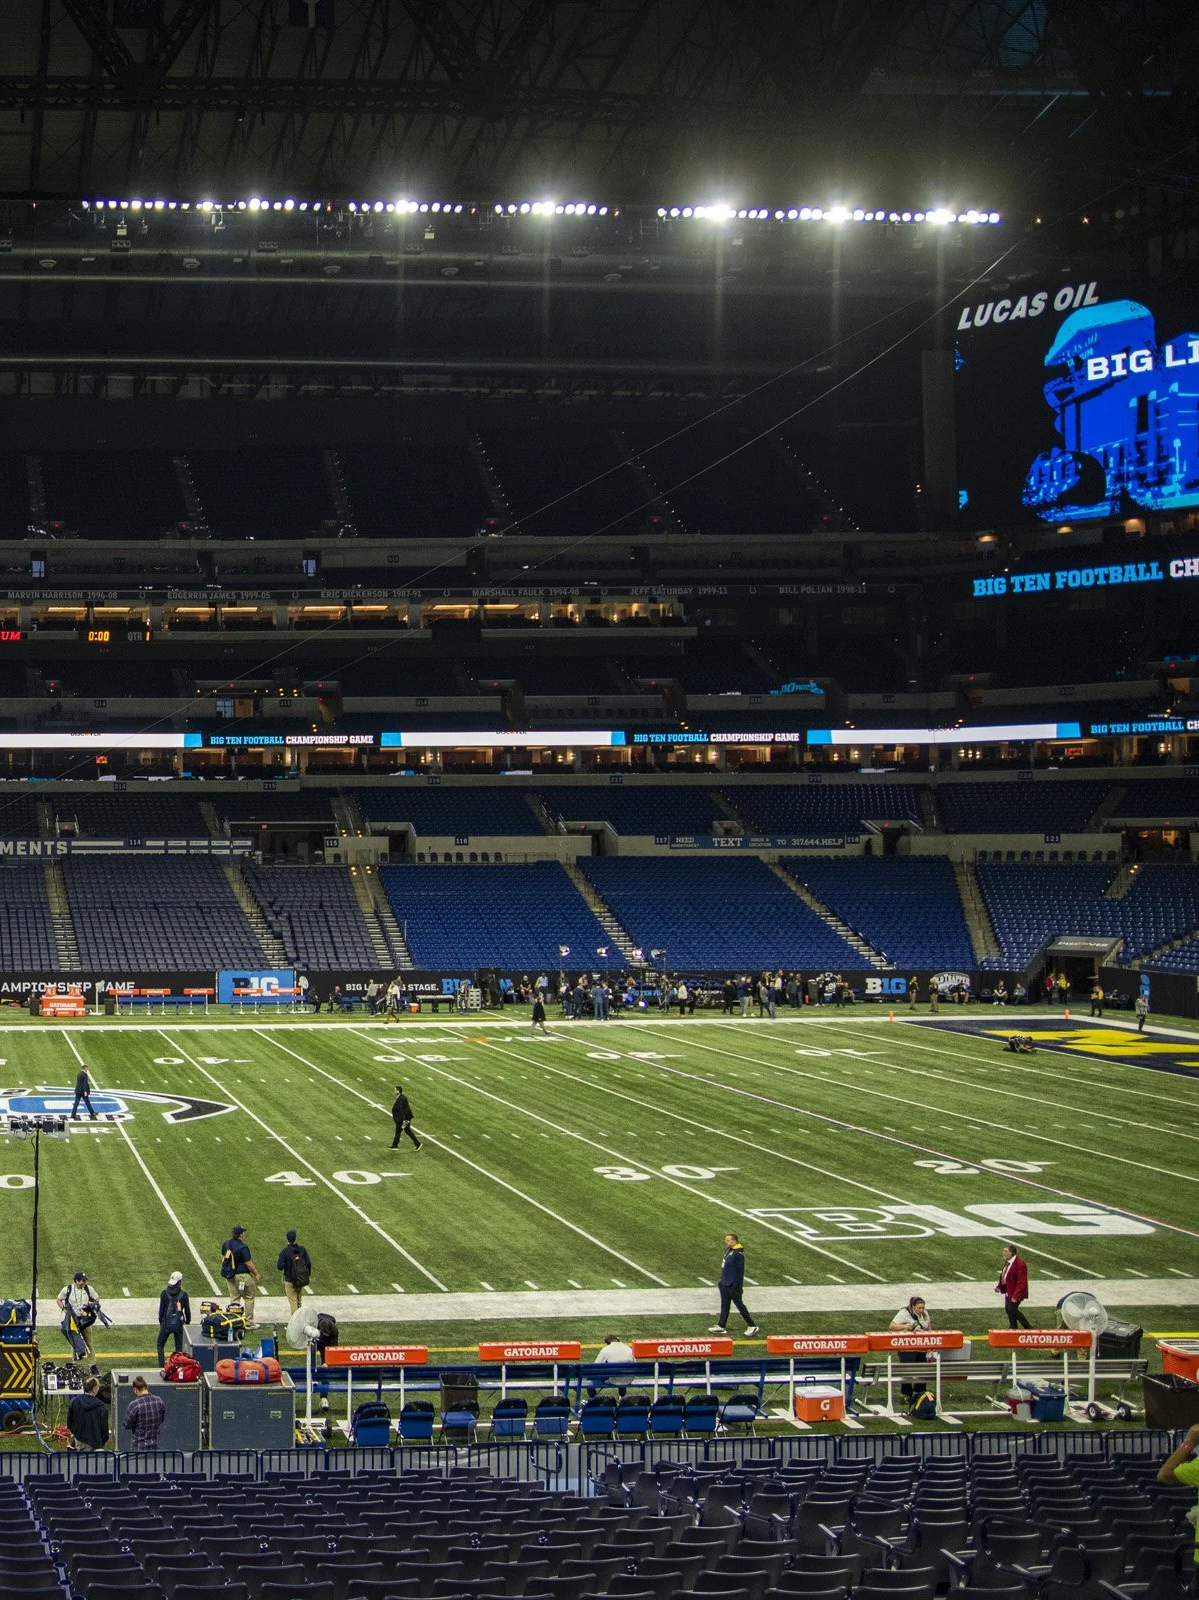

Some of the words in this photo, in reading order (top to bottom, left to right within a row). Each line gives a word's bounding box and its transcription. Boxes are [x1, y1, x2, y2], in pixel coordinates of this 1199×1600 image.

[957, 292, 1048, 330] LUCAS
[1054, 281, 1099, 311] OIL
[1087, 349, 1152, 381] BIG
[973, 577, 1007, 597] BIG
[1010, 572, 1050, 593] TEN
[1055, 561, 1165, 588] FOOTBALL
[8, 591, 39, 600] MARVIN
[42, 591, 83, 600] HARRISON
[208, 591, 236, 600] JAMES
[321, 590, 338, 599] ERIC
[340, 590, 388, 599] DICKERSON
[472, 588, 517, 597] MARSHALL
[519, 588, 544, 597] FAULK
[630, 587, 650, 596] JEFF
[652, 587, 694, 596] SATURDAY
[88, 630, 110, 641] 0:00
[127, 631, 143, 641] QTR
[1090, 724, 1106, 735] BIG
[1110, 723, 1129, 734] TEN
[1131, 721, 1184, 733] FOOTBALL
[210, 735, 224, 744] BIG
[226, 735, 241, 744] TEN
[243, 735, 284, 744] FOOTBALL
[286, 735, 348, 744] CHAMPIONSHIP
[350, 735, 374, 744] GAME
[634, 733, 648, 743] BIG
[650, 733, 665, 743] TEN
[667, 733, 709, 743] FOOTBALL
[710, 733, 774, 743] CHAMPIONSHIP
[775, 733, 800, 743] GAME
[712, 838, 742, 846] TEXT
[792, 838, 843, 846] 317.644.HELP
[890, 1336, 943, 1346] GATORADE
[1018, 1334, 1073, 1344] GATORADE
[657, 1344, 712, 1354] GATORADE
[793, 1340, 848, 1350] GATORADE
[350, 1352, 406, 1362] GATORADE
[504, 1347, 558, 1357] GATORADE
[820, 1399, 830, 1412] G
